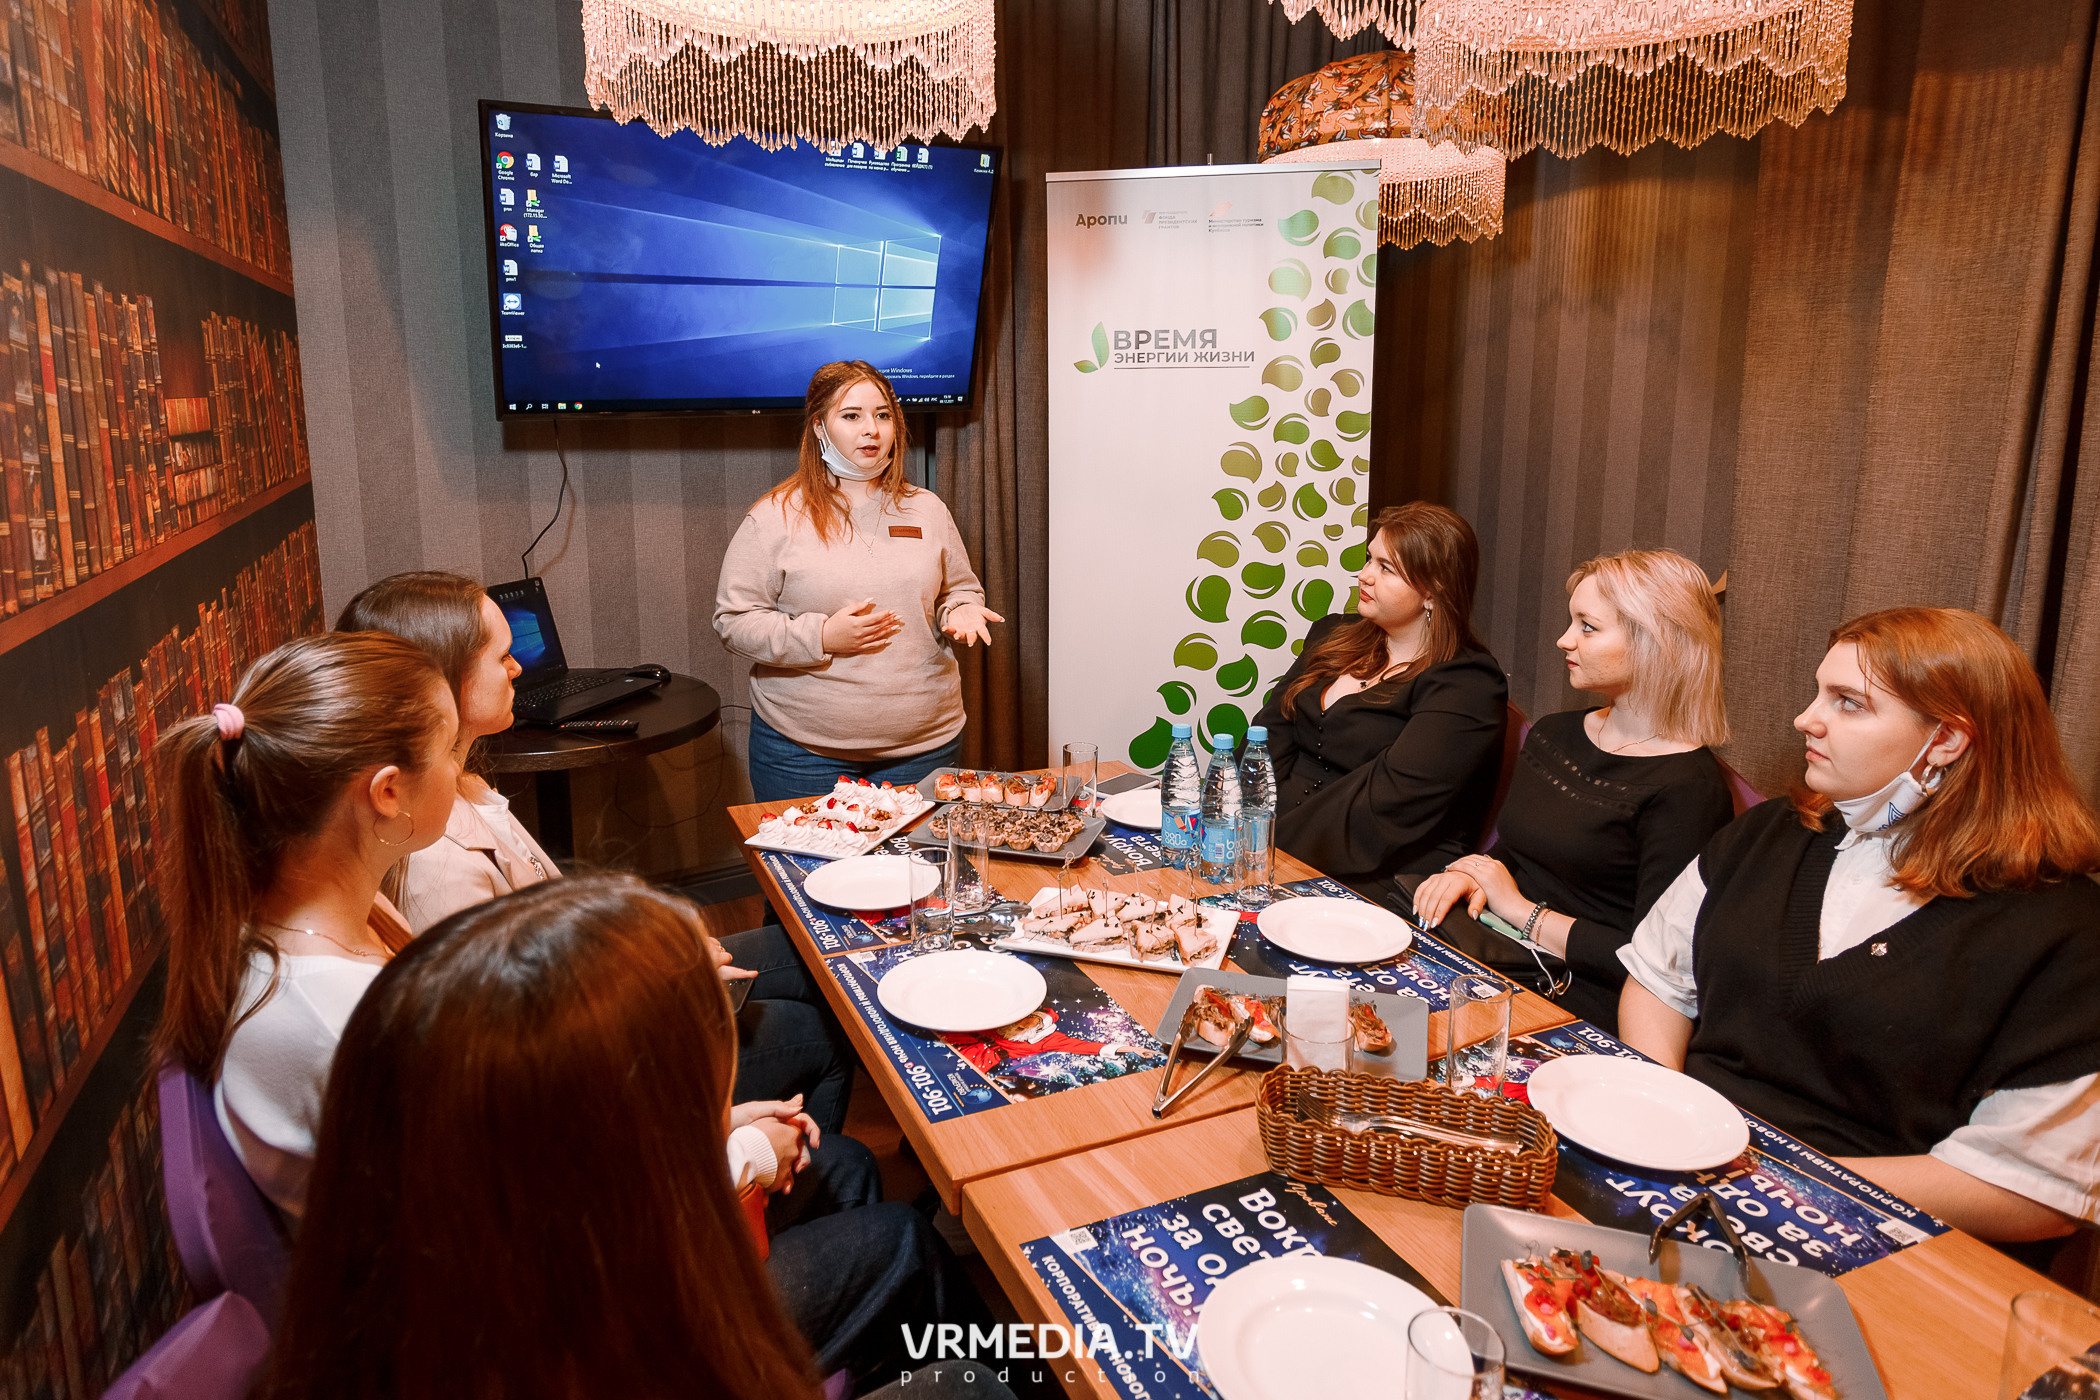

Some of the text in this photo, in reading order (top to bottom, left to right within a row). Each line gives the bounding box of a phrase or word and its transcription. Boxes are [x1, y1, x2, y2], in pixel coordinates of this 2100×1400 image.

[1075, 213, 1128, 229] Аропи
[1113, 328, 1217, 350] ВРЕМЯ
[1114, 351, 1256, 365] ЭНЕРГИИ ЖИЗНИ
[1317, 880, 1357, 900] 01-901
[810, 919, 841, 950] 901-901
[1577, 1027, 1642, 1060] 01-901
[890, 1044, 909, 1063] НОЧЬ
[906, 1065, 952, 1115] 901-901
[1786, 1138, 1802, 1152] И
[1800, 1150, 1916, 1218] КОРПОРАТИВЫ
[1162, 1214, 1203, 1250] за
[1605, 1178, 1734, 1254] округ
[1777, 1220, 1834, 1258] за
